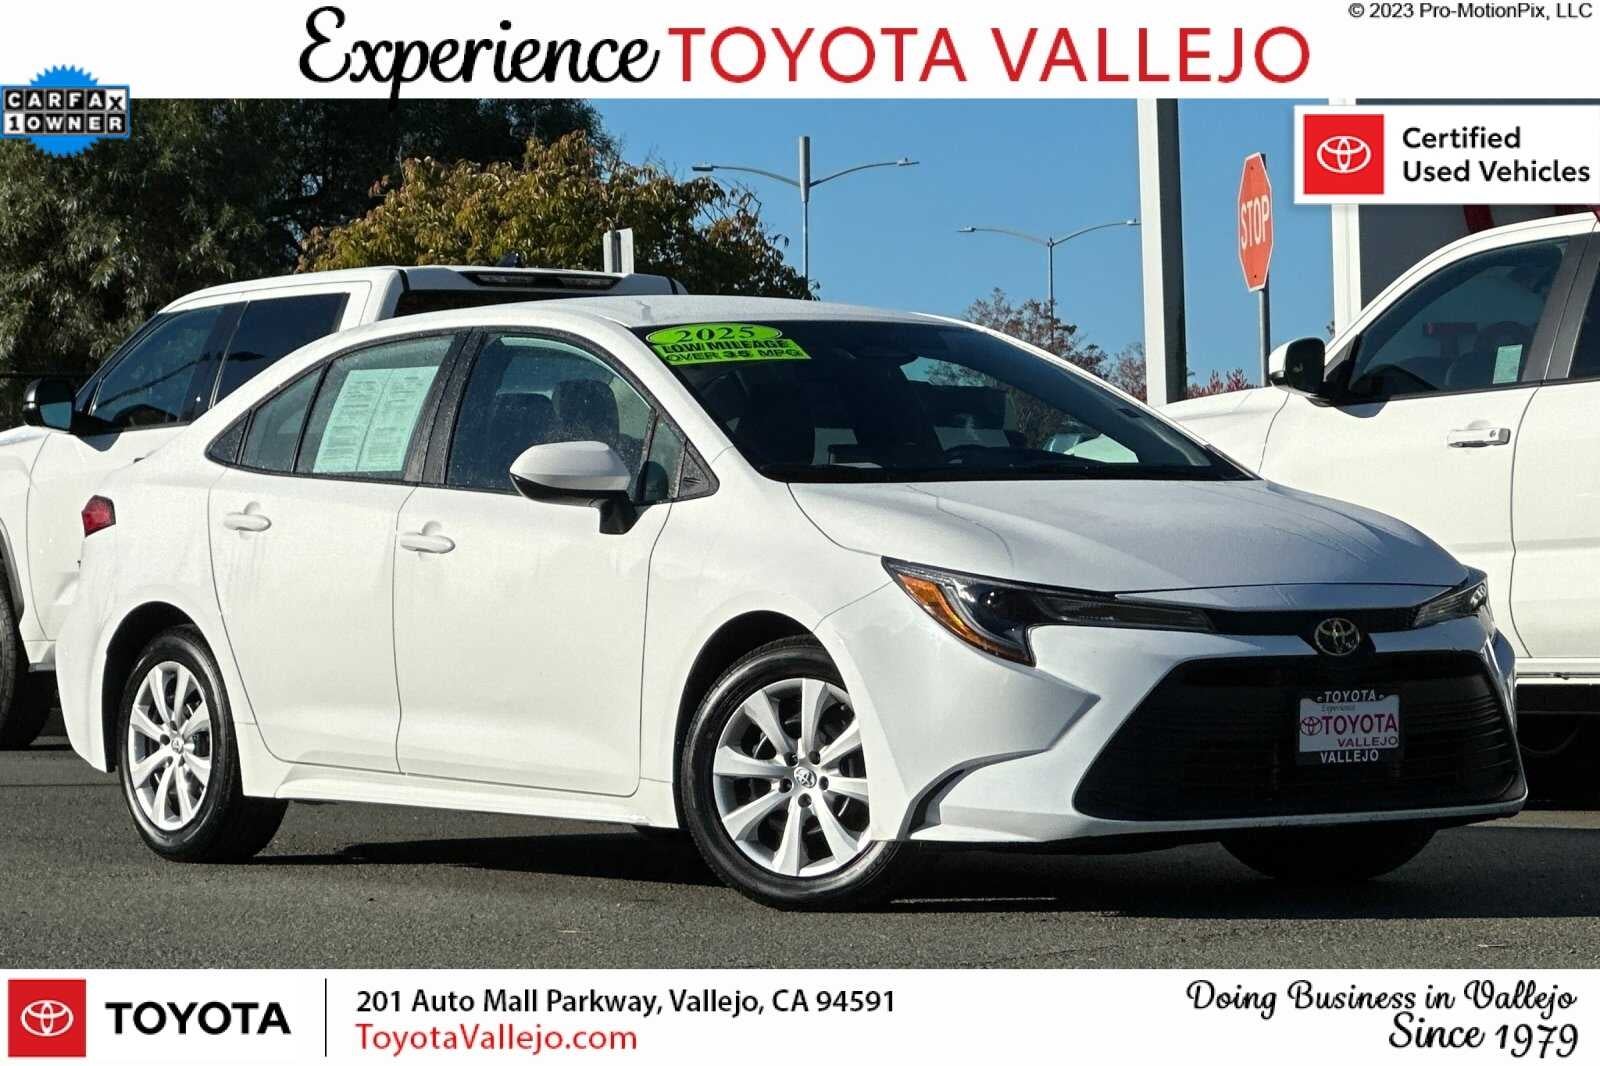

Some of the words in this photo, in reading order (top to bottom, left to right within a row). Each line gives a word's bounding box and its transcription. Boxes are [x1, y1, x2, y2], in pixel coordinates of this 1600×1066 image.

[1240, 194, 1270, 251] STOP
[675, 327, 755, 343] 2025
[665, 351, 720, 362] OVER
[758, 348, 802, 357] MPG
[1324, 689, 1376, 703] TOYOTA
[1321, 713, 1398, 736] TOYOTA
[1337, 735, 1399, 748] VALLEJO
[1320, 749, 1379, 764] VALLEJO
